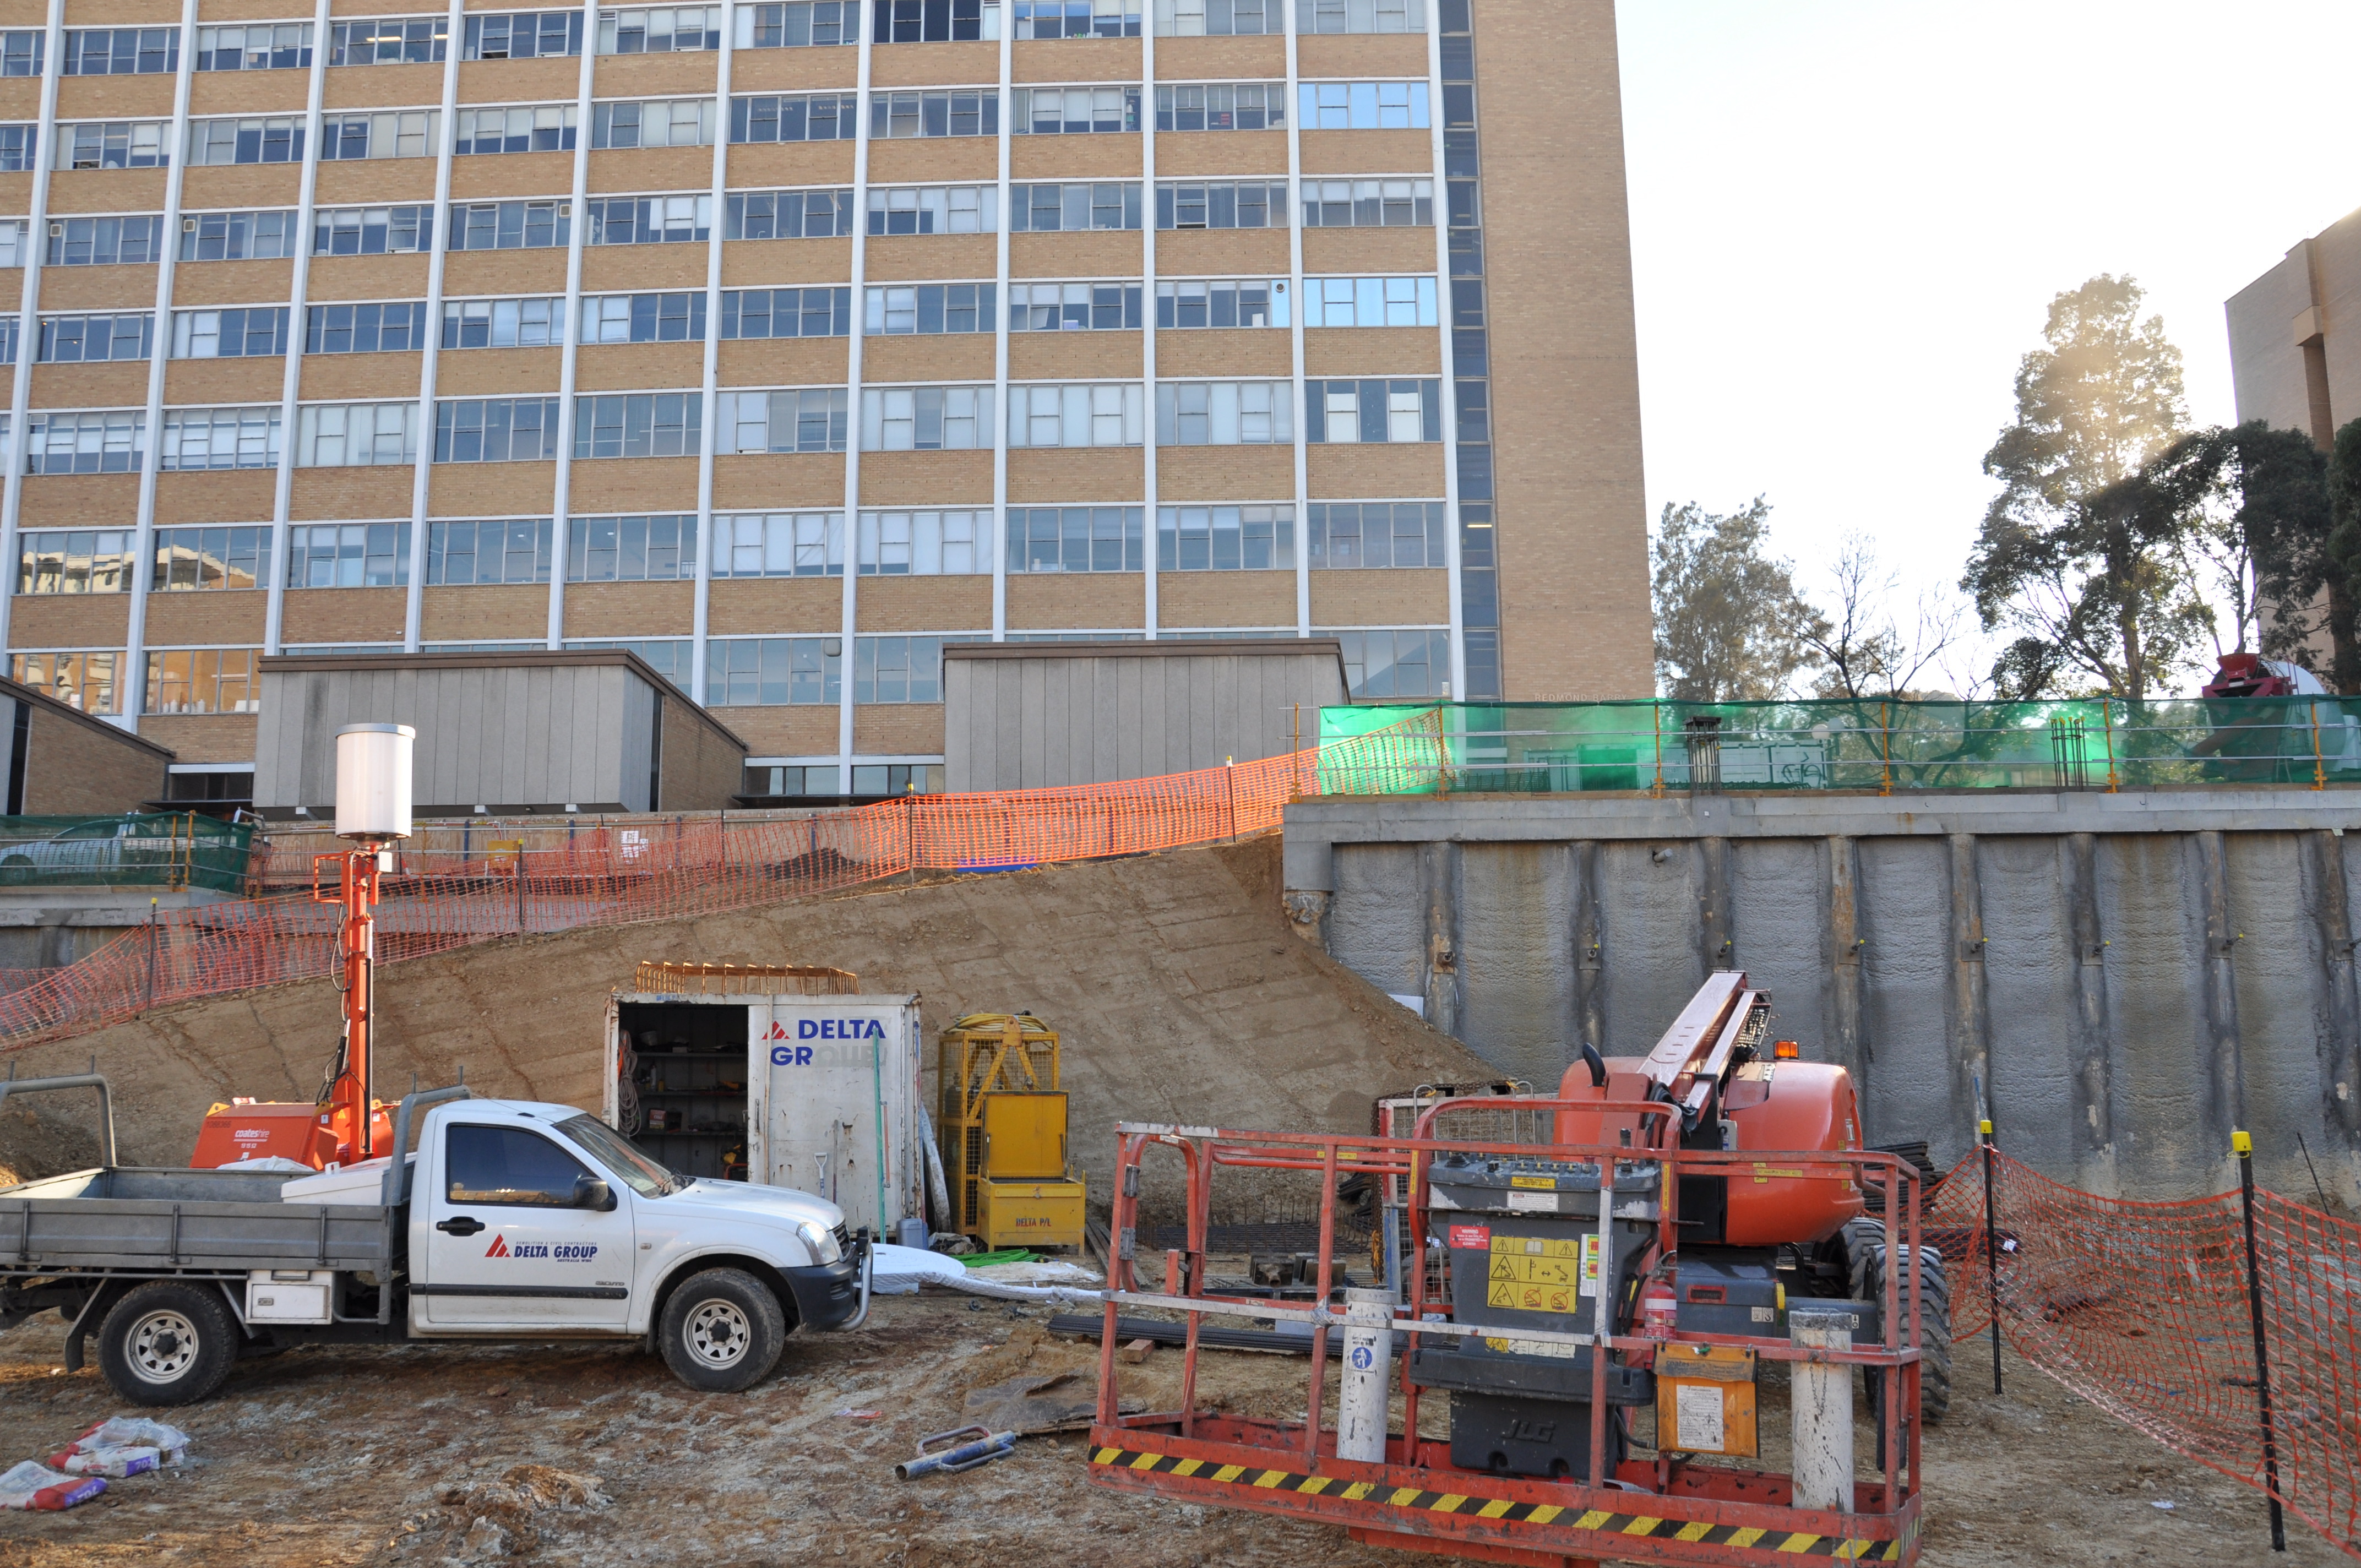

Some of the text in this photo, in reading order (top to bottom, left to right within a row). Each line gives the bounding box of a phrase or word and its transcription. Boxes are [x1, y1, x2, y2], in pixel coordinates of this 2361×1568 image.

[1535, 694, 1587, 702] REDMOND
[798, 1020, 886, 1039] DELTA
[1016, 1217, 1051, 1227] DELTA P/L
[514, 1246, 597, 1258] DELTA GROUP
[1500, 1419, 1557, 1444] JLG
